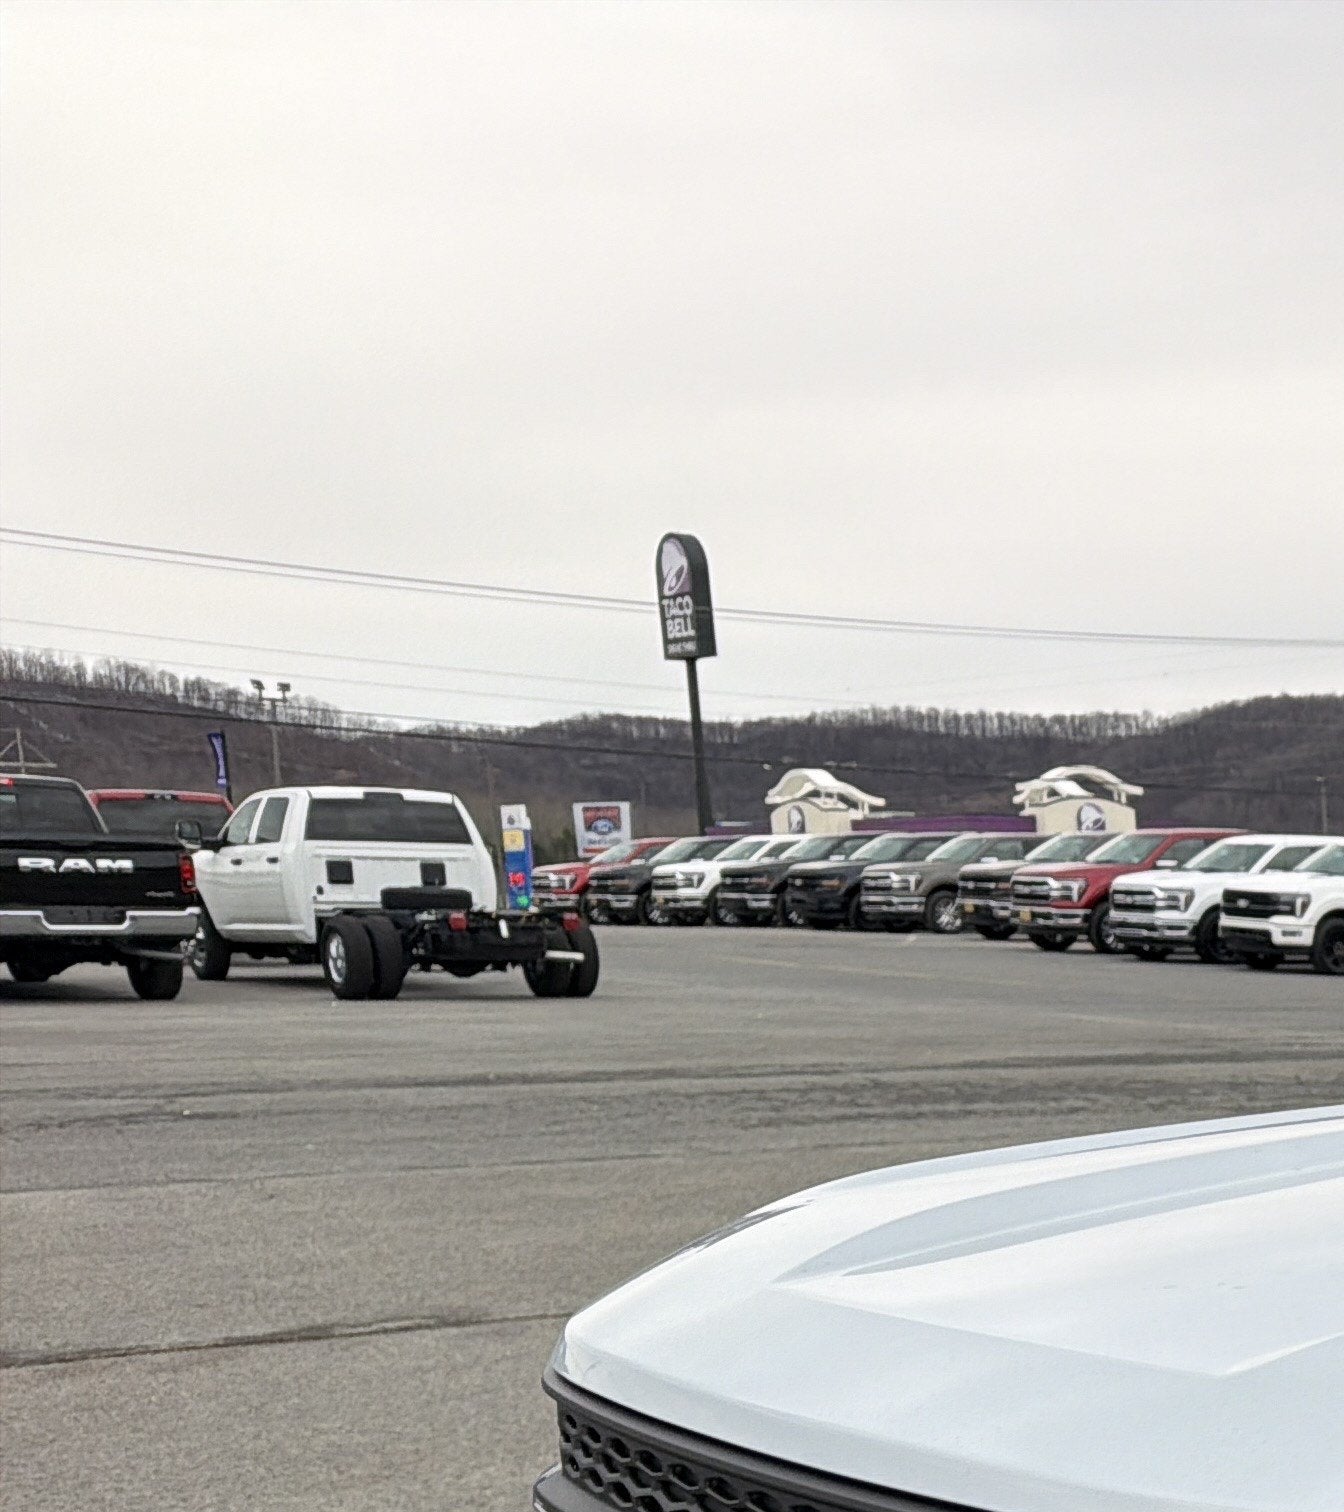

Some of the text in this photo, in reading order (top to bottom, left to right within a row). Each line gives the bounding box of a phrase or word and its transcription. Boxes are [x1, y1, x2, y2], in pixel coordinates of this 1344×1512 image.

[662, 595, 693, 618] TACO
[665, 616, 696, 639] BELL
[17, 857, 133, 874] RAM
